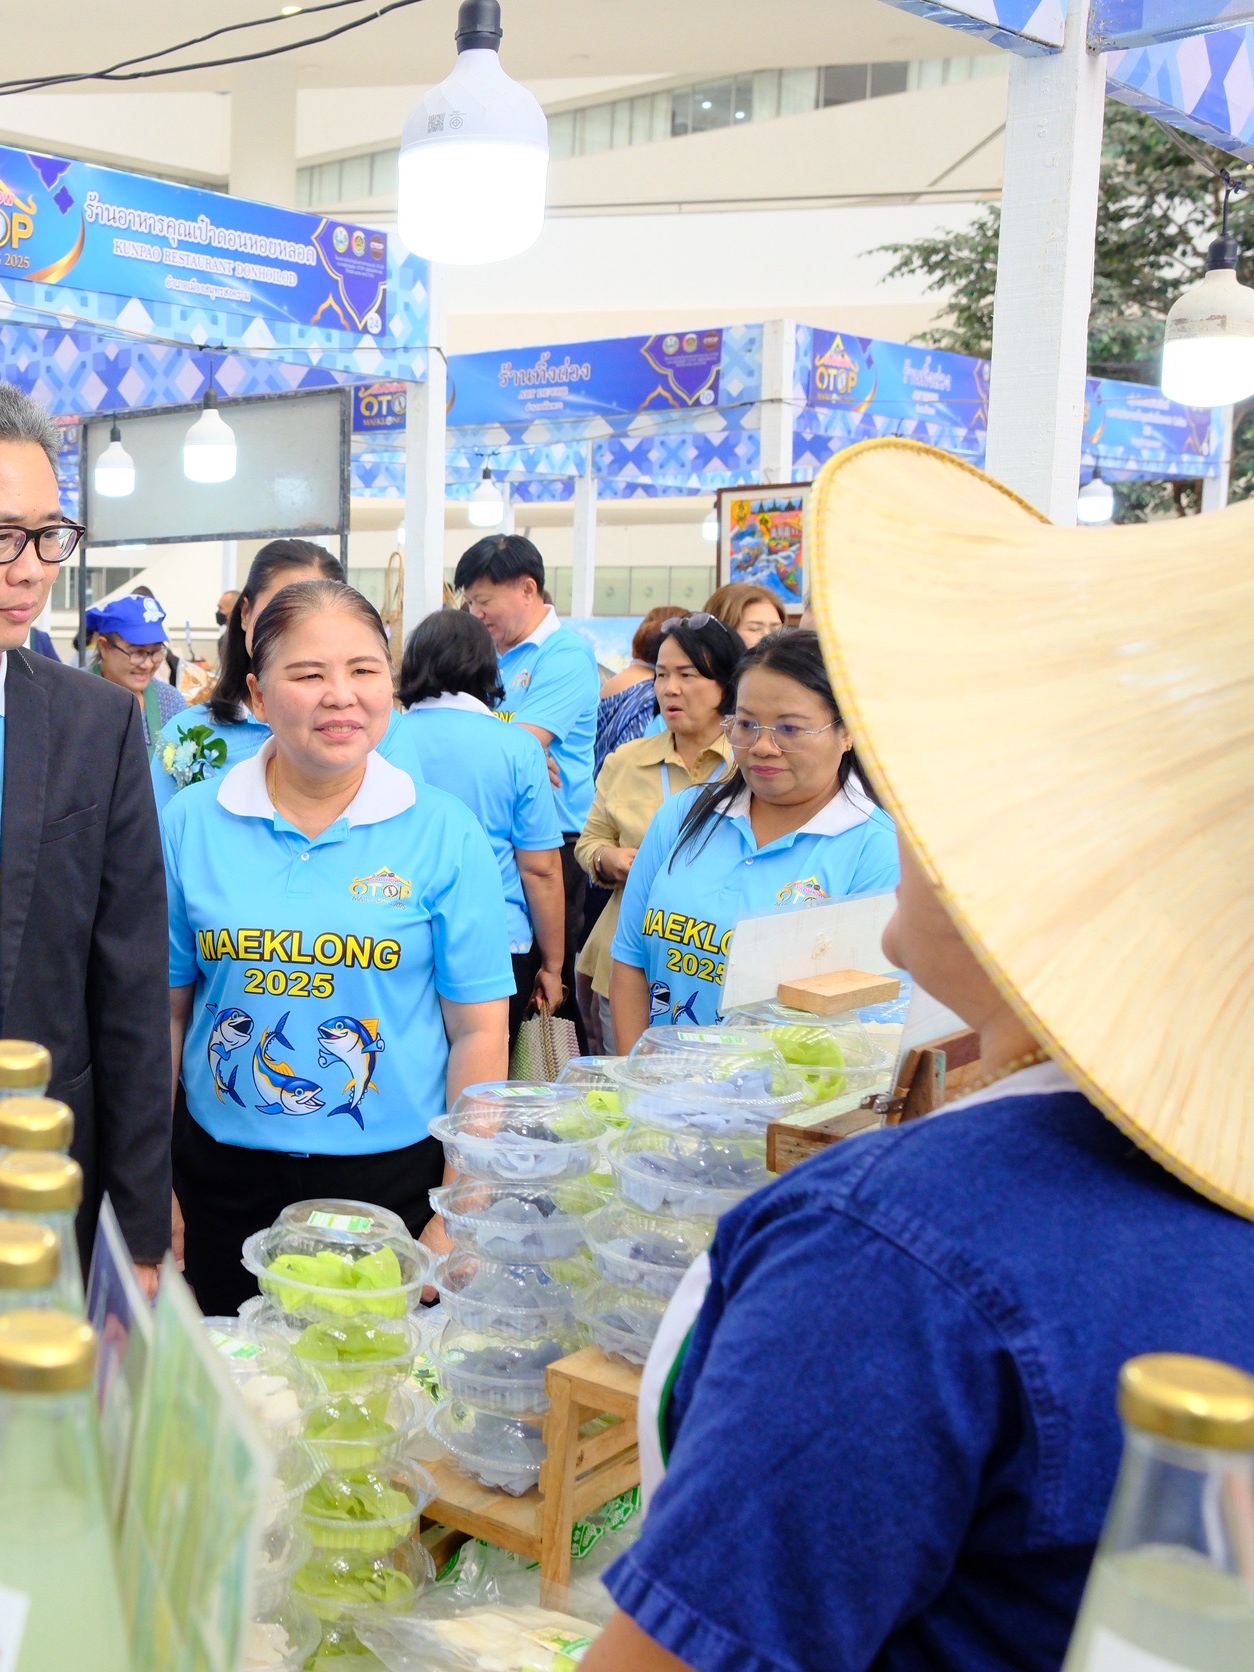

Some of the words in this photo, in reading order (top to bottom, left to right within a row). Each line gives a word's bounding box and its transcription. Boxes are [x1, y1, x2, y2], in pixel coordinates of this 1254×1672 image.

[4, 253, 30, 269] 2025
[113, 239, 162, 262] KUNPAO
[163, 249, 235, 276] RESTAURANT
[235, 262, 298, 287] DONHOILOD
[369, 316, 380, 329] 24
[815, 366, 858, 394] OTOP
[350, 881, 411, 900] OTOP
[199, 929, 402, 971] MAEKLONG
[244, 968, 334, 998] 2025
